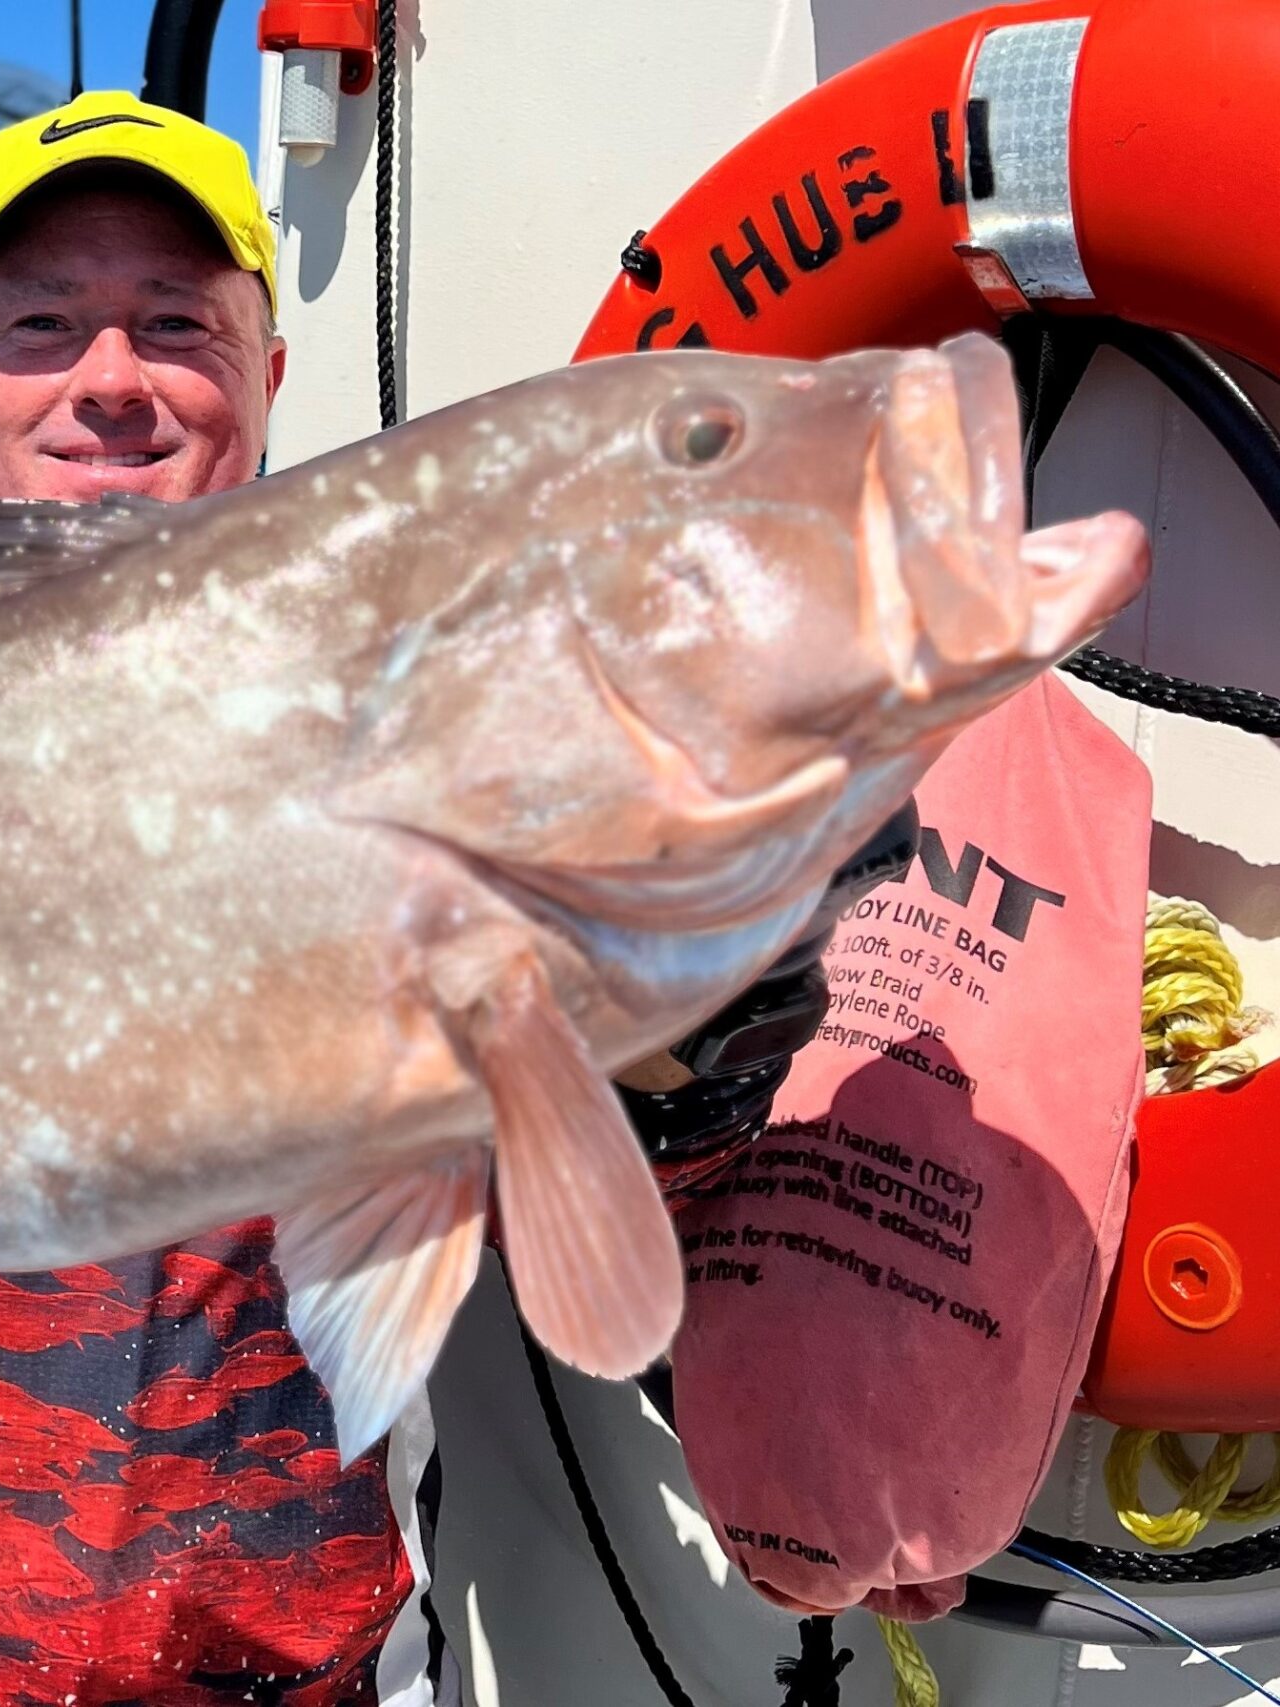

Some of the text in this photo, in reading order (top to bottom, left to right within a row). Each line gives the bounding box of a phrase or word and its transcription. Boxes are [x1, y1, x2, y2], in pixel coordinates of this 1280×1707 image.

[710, 145, 903, 318] HUB
[841, 935, 892, 959] 100ft.
[900, 949, 924, 967] of
[925, 955, 964, 988] 3/8
[966, 976, 989, 1005] in.
[893, 903, 951, 939] LINE
[955, 927, 1007, 973] BAG
[870, 969, 923, 1002] Braid
[812, 1020, 978, 1096] fetyproducts.com
[893, 1004, 946, 1044] Rope
[755, 1148, 972, 1239] opening (BOTTOM)
[836, 1121, 913, 1174] handle
[920, 1159, 983, 1210] (TOP)
[784, 1175, 829, 1203] with
[833, 1184, 874, 1220] line
[878, 1208, 972, 1266] attached
[741, 1223, 773, 1248] for
[776, 1231, 882, 1288] retrieving
[887, 1266, 945, 1314] buoy
[950, 1301, 1002, 1340] only.
[760, 1531, 781, 1551] IN
[785, 1536, 840, 1570] CHINA
